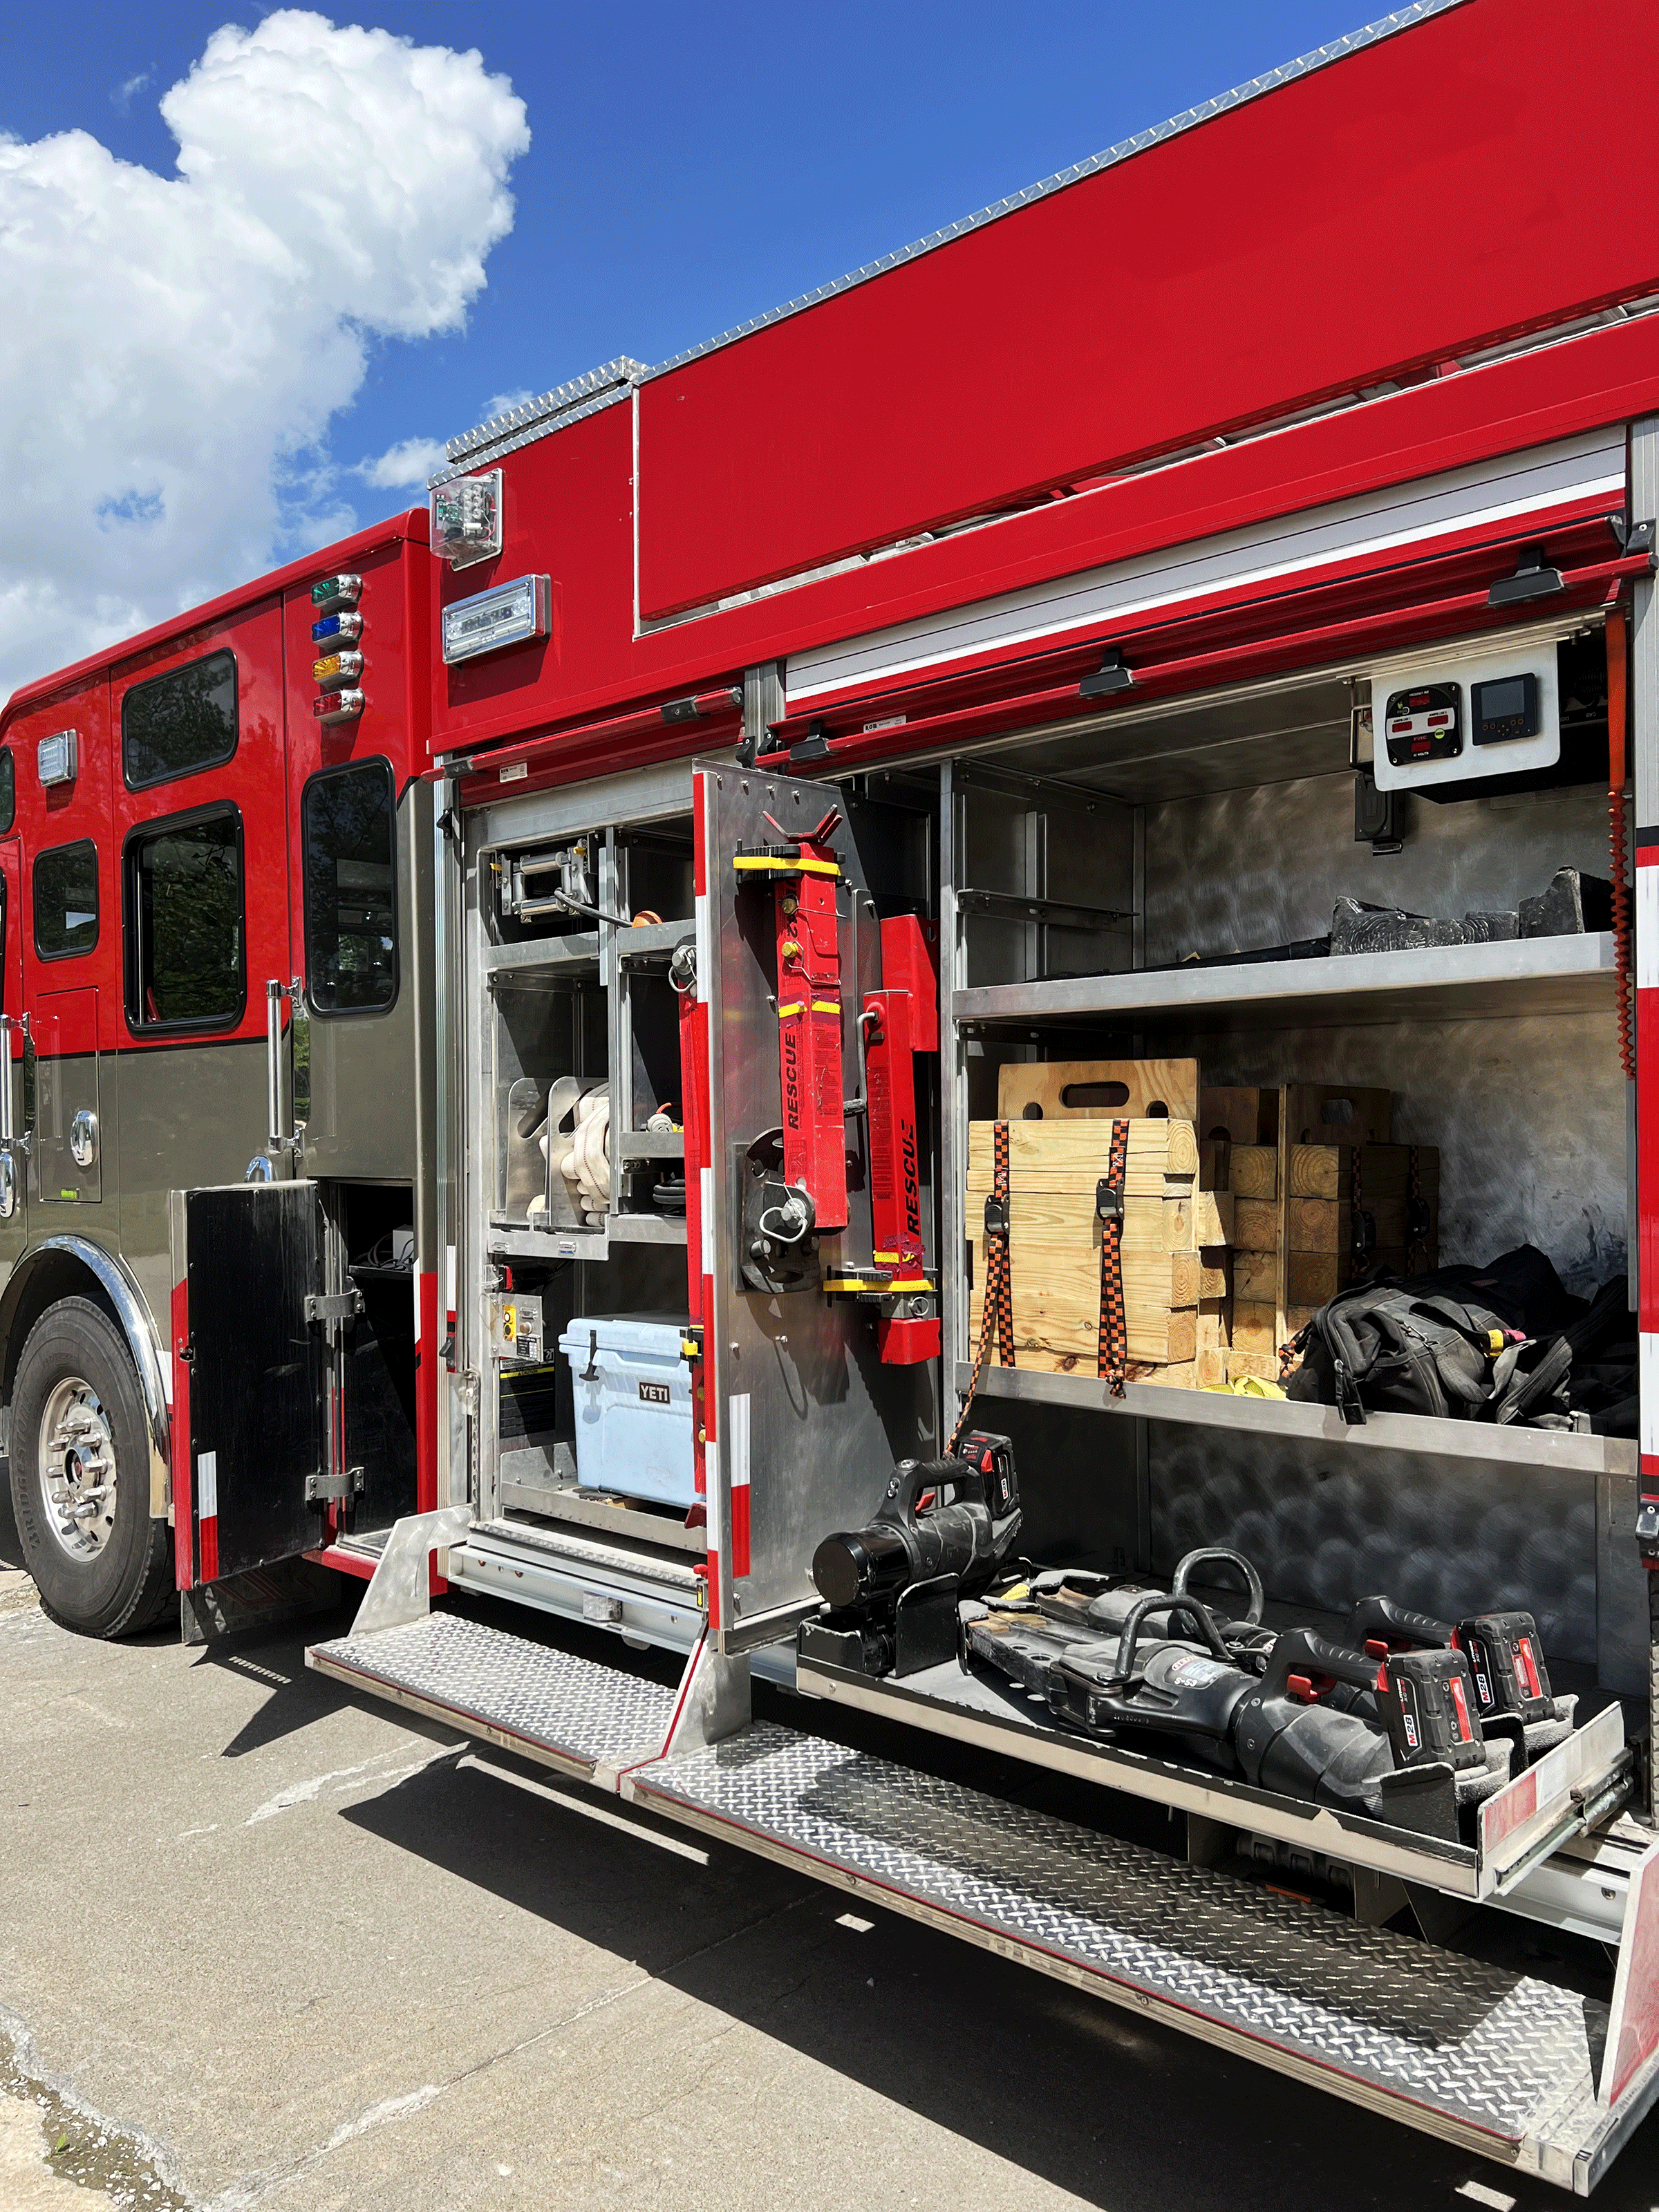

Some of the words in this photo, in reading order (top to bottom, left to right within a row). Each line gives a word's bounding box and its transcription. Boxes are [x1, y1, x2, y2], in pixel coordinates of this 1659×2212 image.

[785, 1033, 799, 1130] RESCUE
[901, 1118, 920, 1236] RESCUE
[640, 1385, 668, 1400] YETI
[15, 1391, 41, 1550] BRIDGESTONE
[1479, 1676, 1489, 1701] M28
[1405, 1717, 1417, 1745] M28
